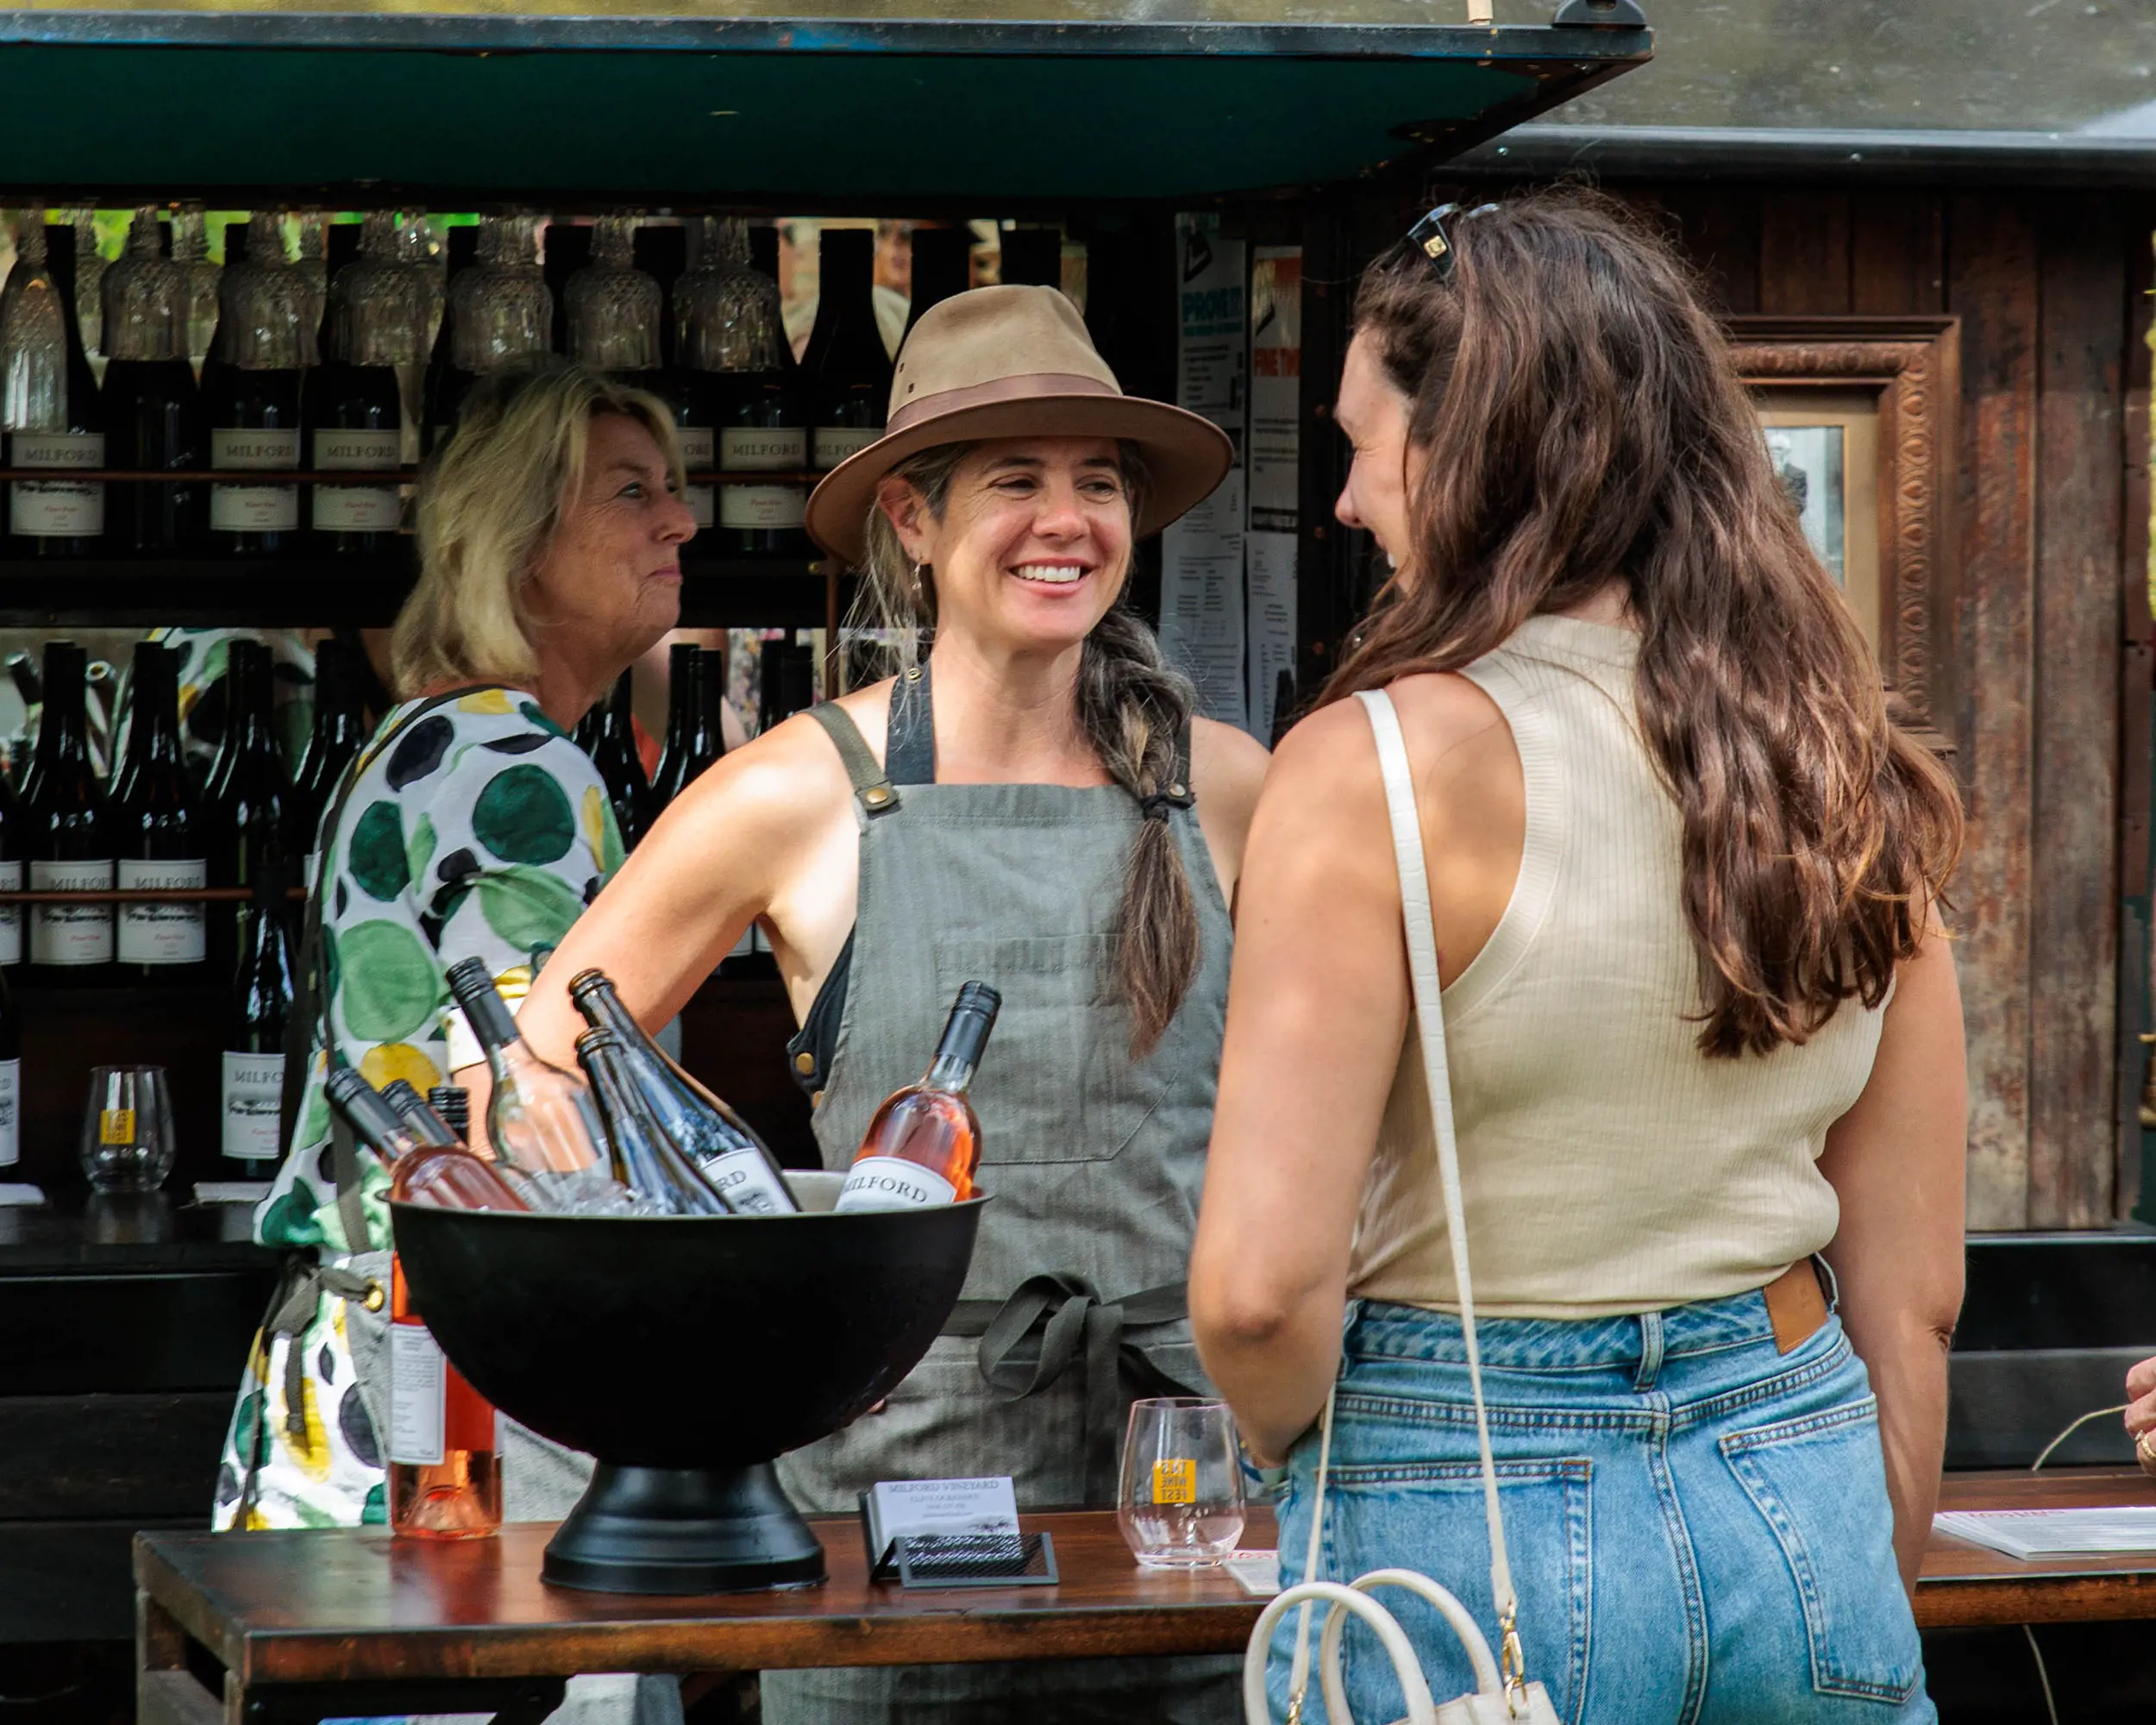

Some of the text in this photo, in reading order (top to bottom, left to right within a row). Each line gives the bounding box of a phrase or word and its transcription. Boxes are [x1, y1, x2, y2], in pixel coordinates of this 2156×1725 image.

[733, 442, 800, 457] MILFORD
[234, 1070, 284, 1084] MILFO
[713, 1170, 747, 1190] RD
[888, 1480, 1000, 1493] MILFORD VINEYARD
